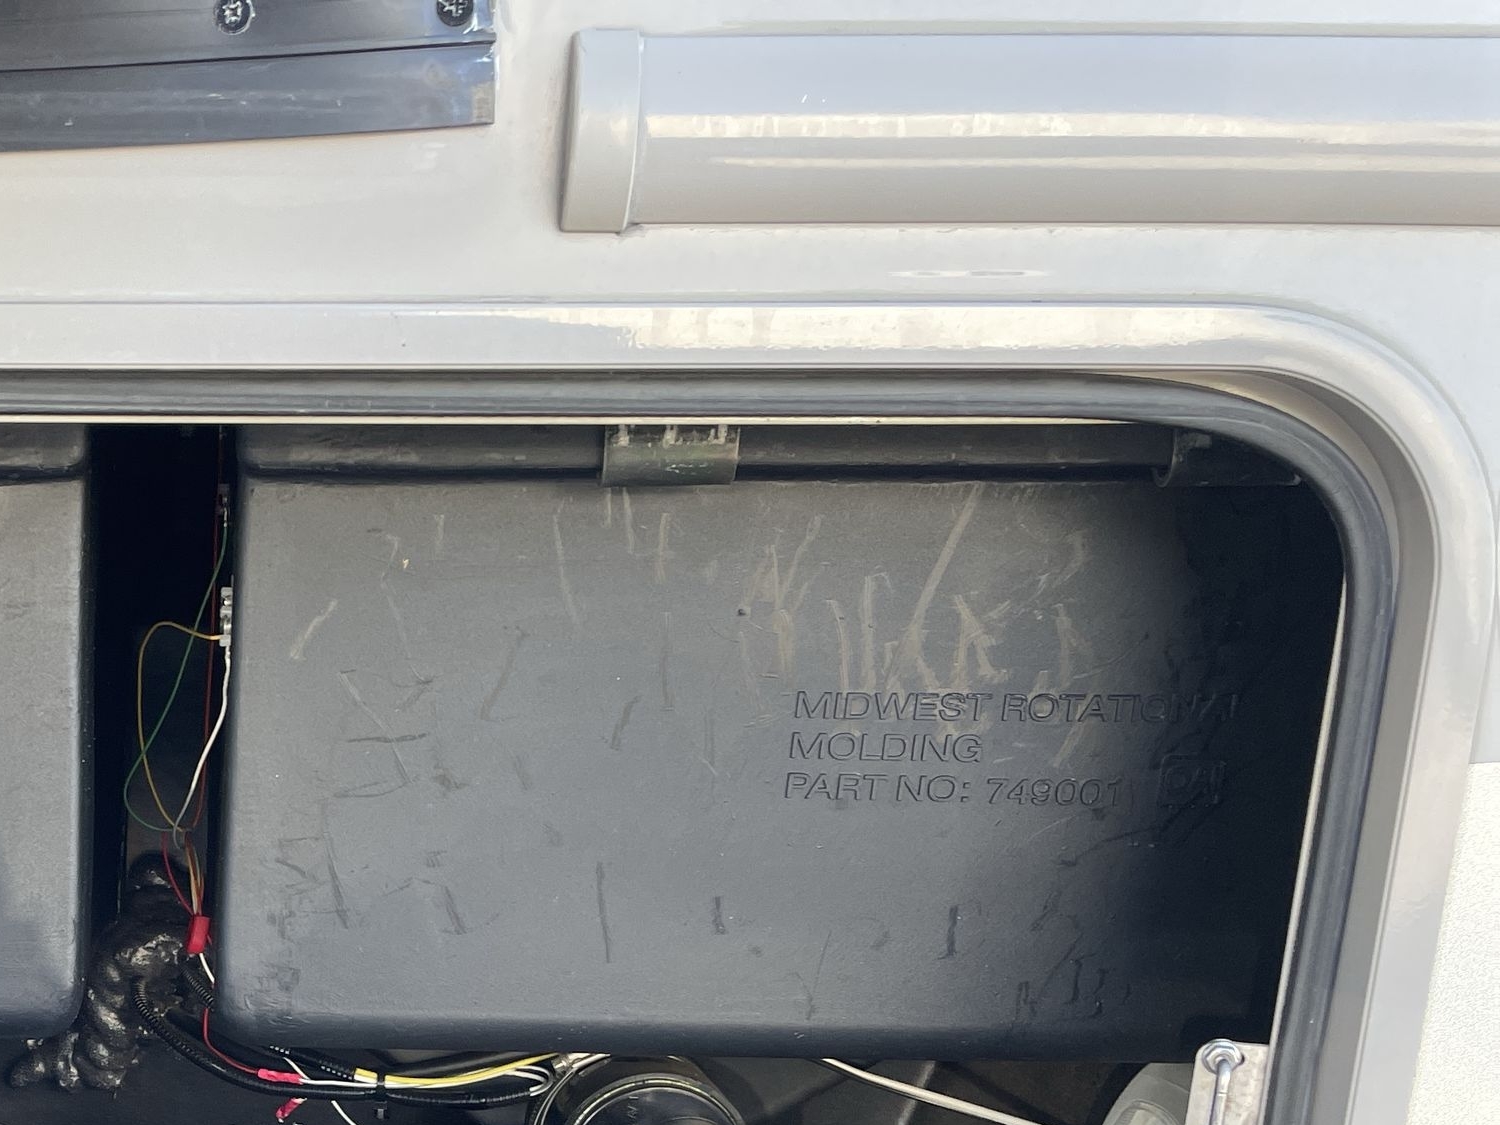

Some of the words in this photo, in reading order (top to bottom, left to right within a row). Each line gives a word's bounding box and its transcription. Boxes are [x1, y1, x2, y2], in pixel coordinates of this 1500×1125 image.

[794, 691, 993, 722] MIDWEST
[789, 731, 983, 763] MOLDING
[784, 772, 889, 801] PART
[896, 774, 972, 802] NO:
[986, 778, 1124, 806] 749001
